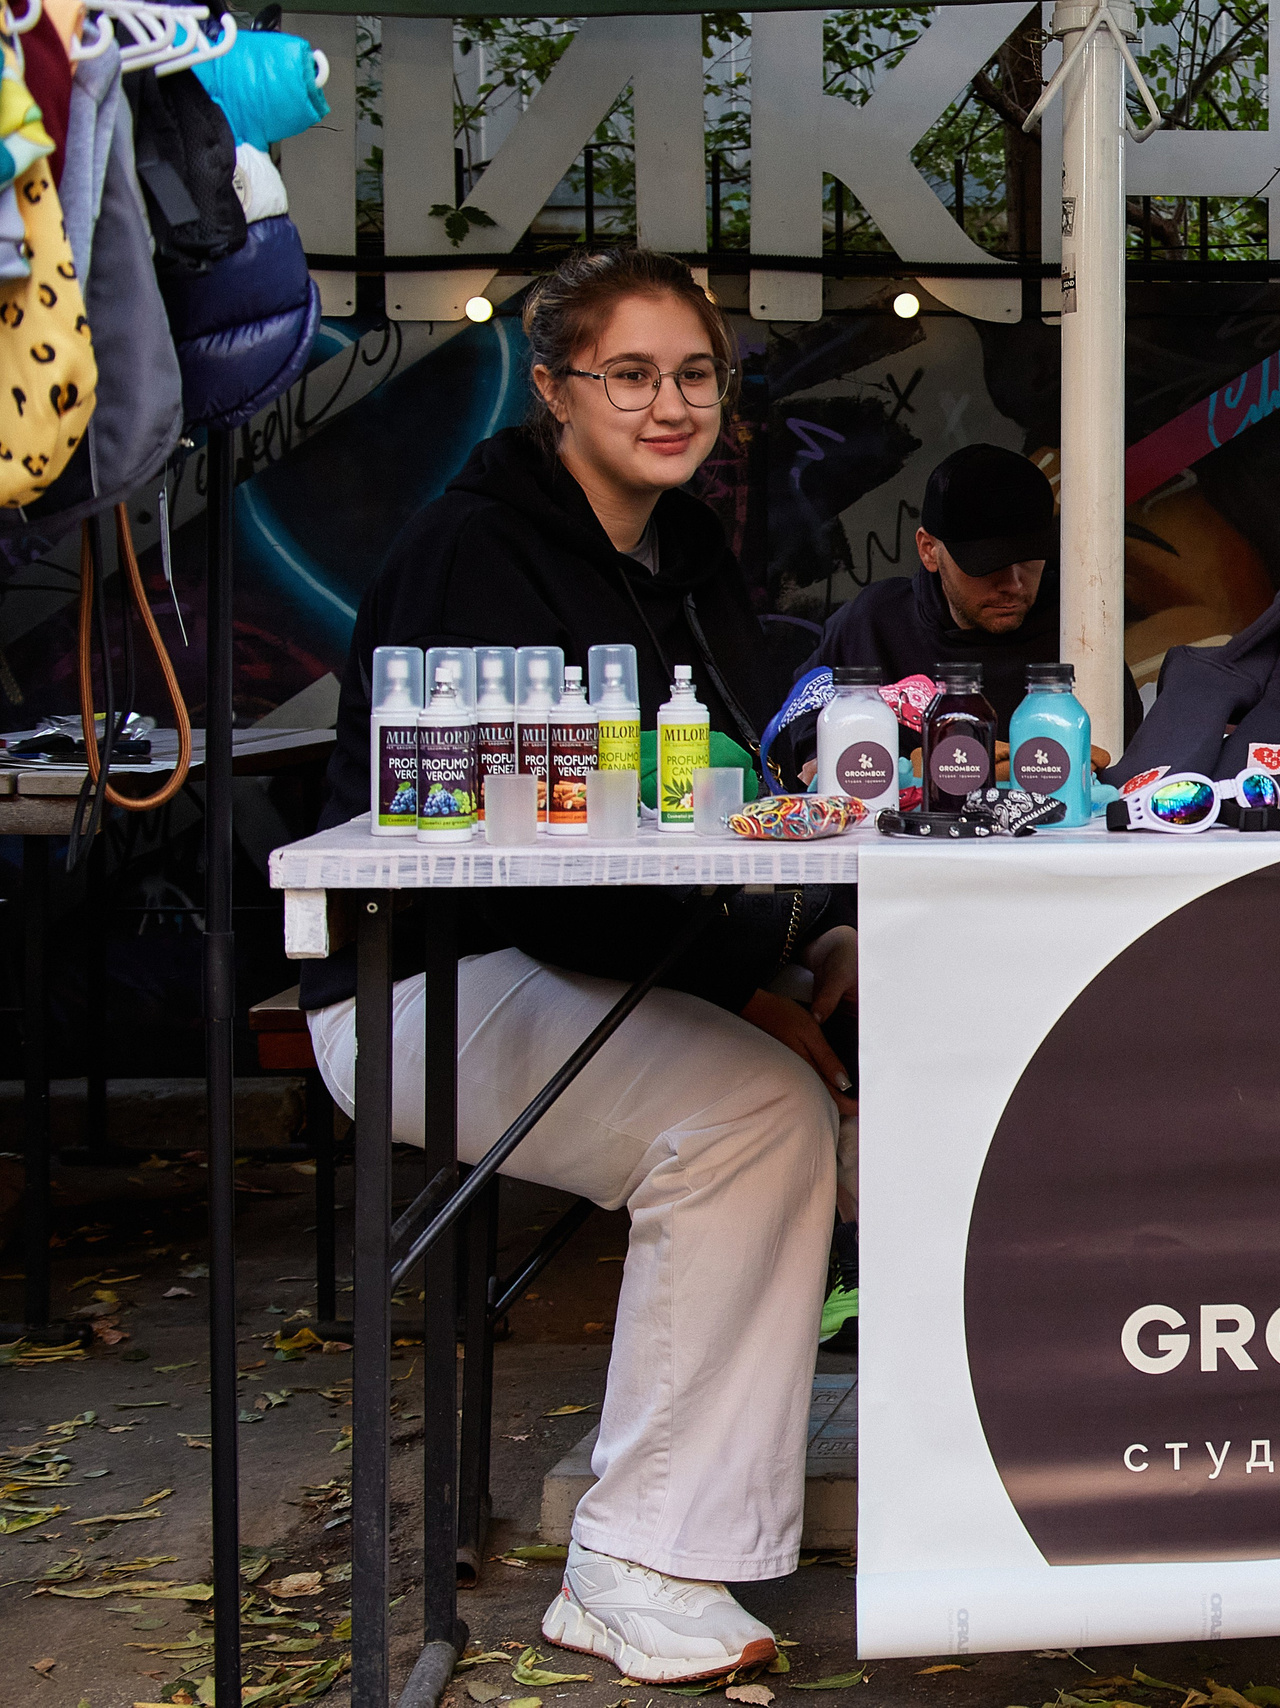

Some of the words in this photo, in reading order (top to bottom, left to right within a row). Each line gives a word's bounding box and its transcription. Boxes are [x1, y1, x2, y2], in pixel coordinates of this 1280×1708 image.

[420, 731, 470, 745] MILORD
[551, 728, 599, 742] MILORD
[422, 757, 469, 770] PROFUMO
[481, 753, 515, 764] PROFU
[553, 754, 598, 766] PROFUMO
[666, 754, 709, 765] PROFUMO
[426, 770, 465, 781] VERONA
